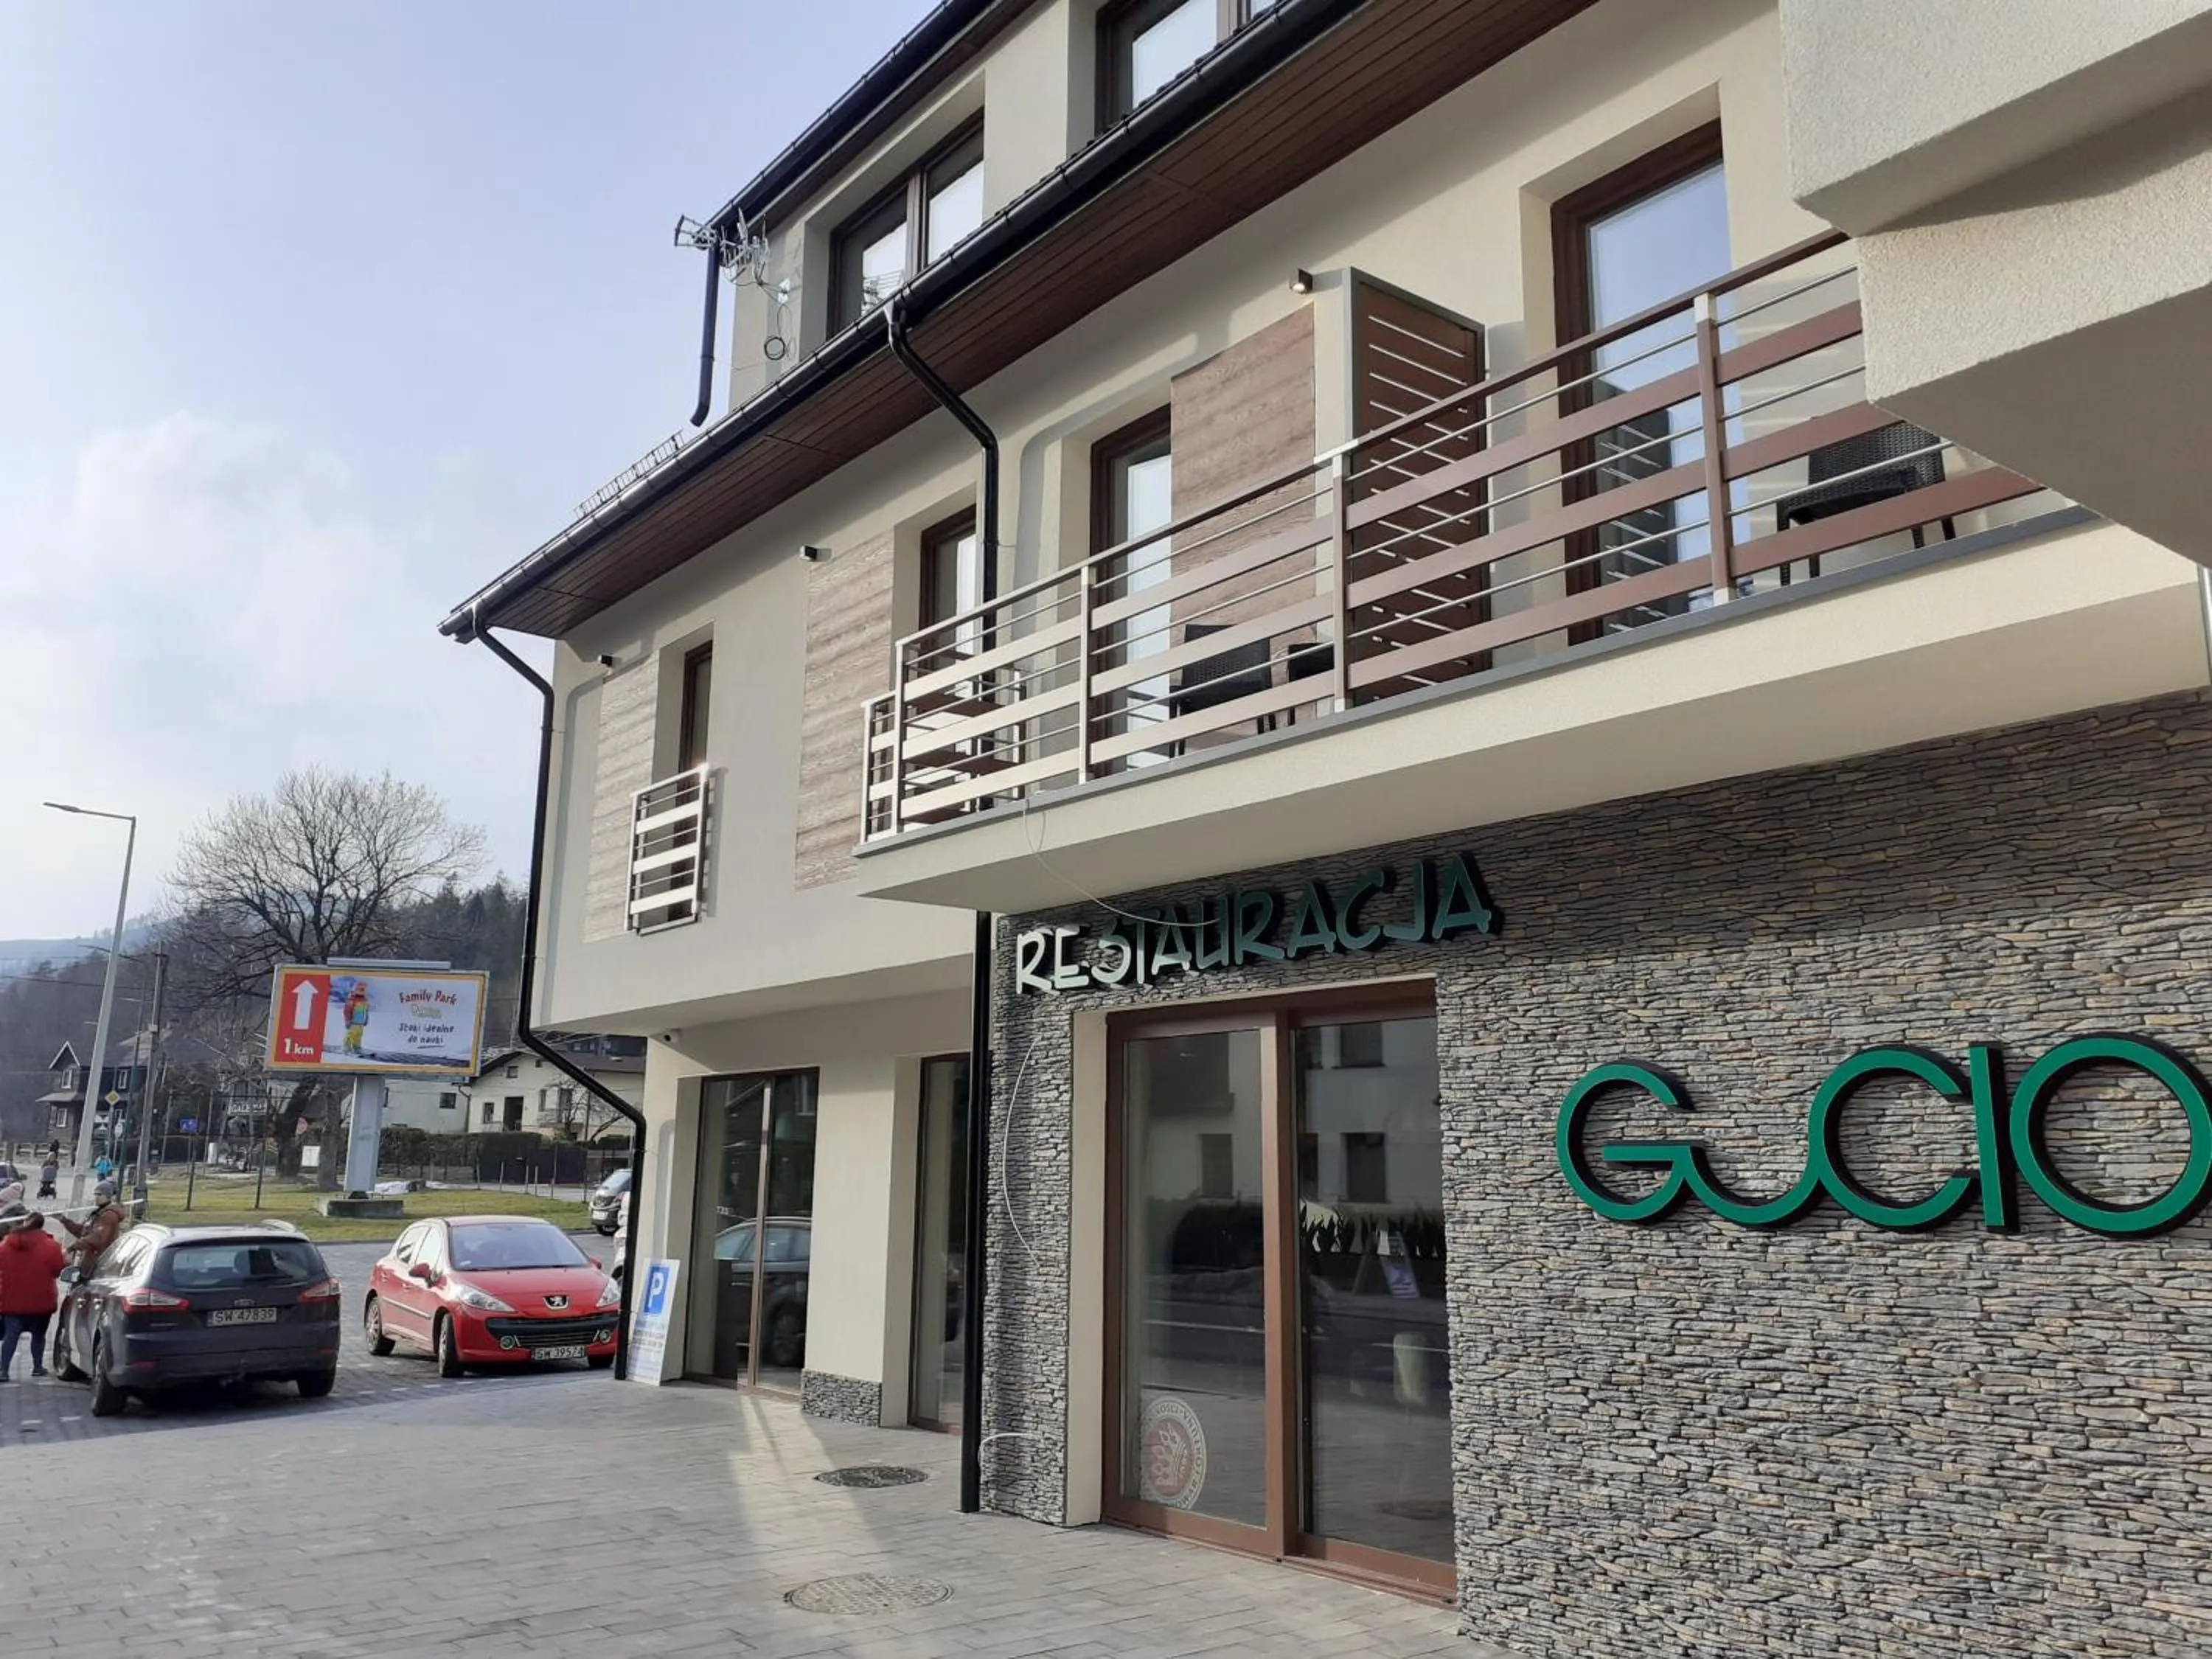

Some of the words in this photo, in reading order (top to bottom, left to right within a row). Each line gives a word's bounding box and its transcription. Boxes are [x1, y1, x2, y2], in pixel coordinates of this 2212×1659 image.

[1015, 852, 1492, 995] RESTAURACJA
[399, 989, 432, 1004] Family
[284, 1037, 292, 1054] 1
[294, 1043, 314, 1055] km
[1556, 1035, 2212, 1236] GUCIO
[648, 1271, 665, 1308] P
[215, 1310, 234, 1323] SW
[237, 1309, 274, 1321] 47839
[536, 1349, 551, 1359] SW
